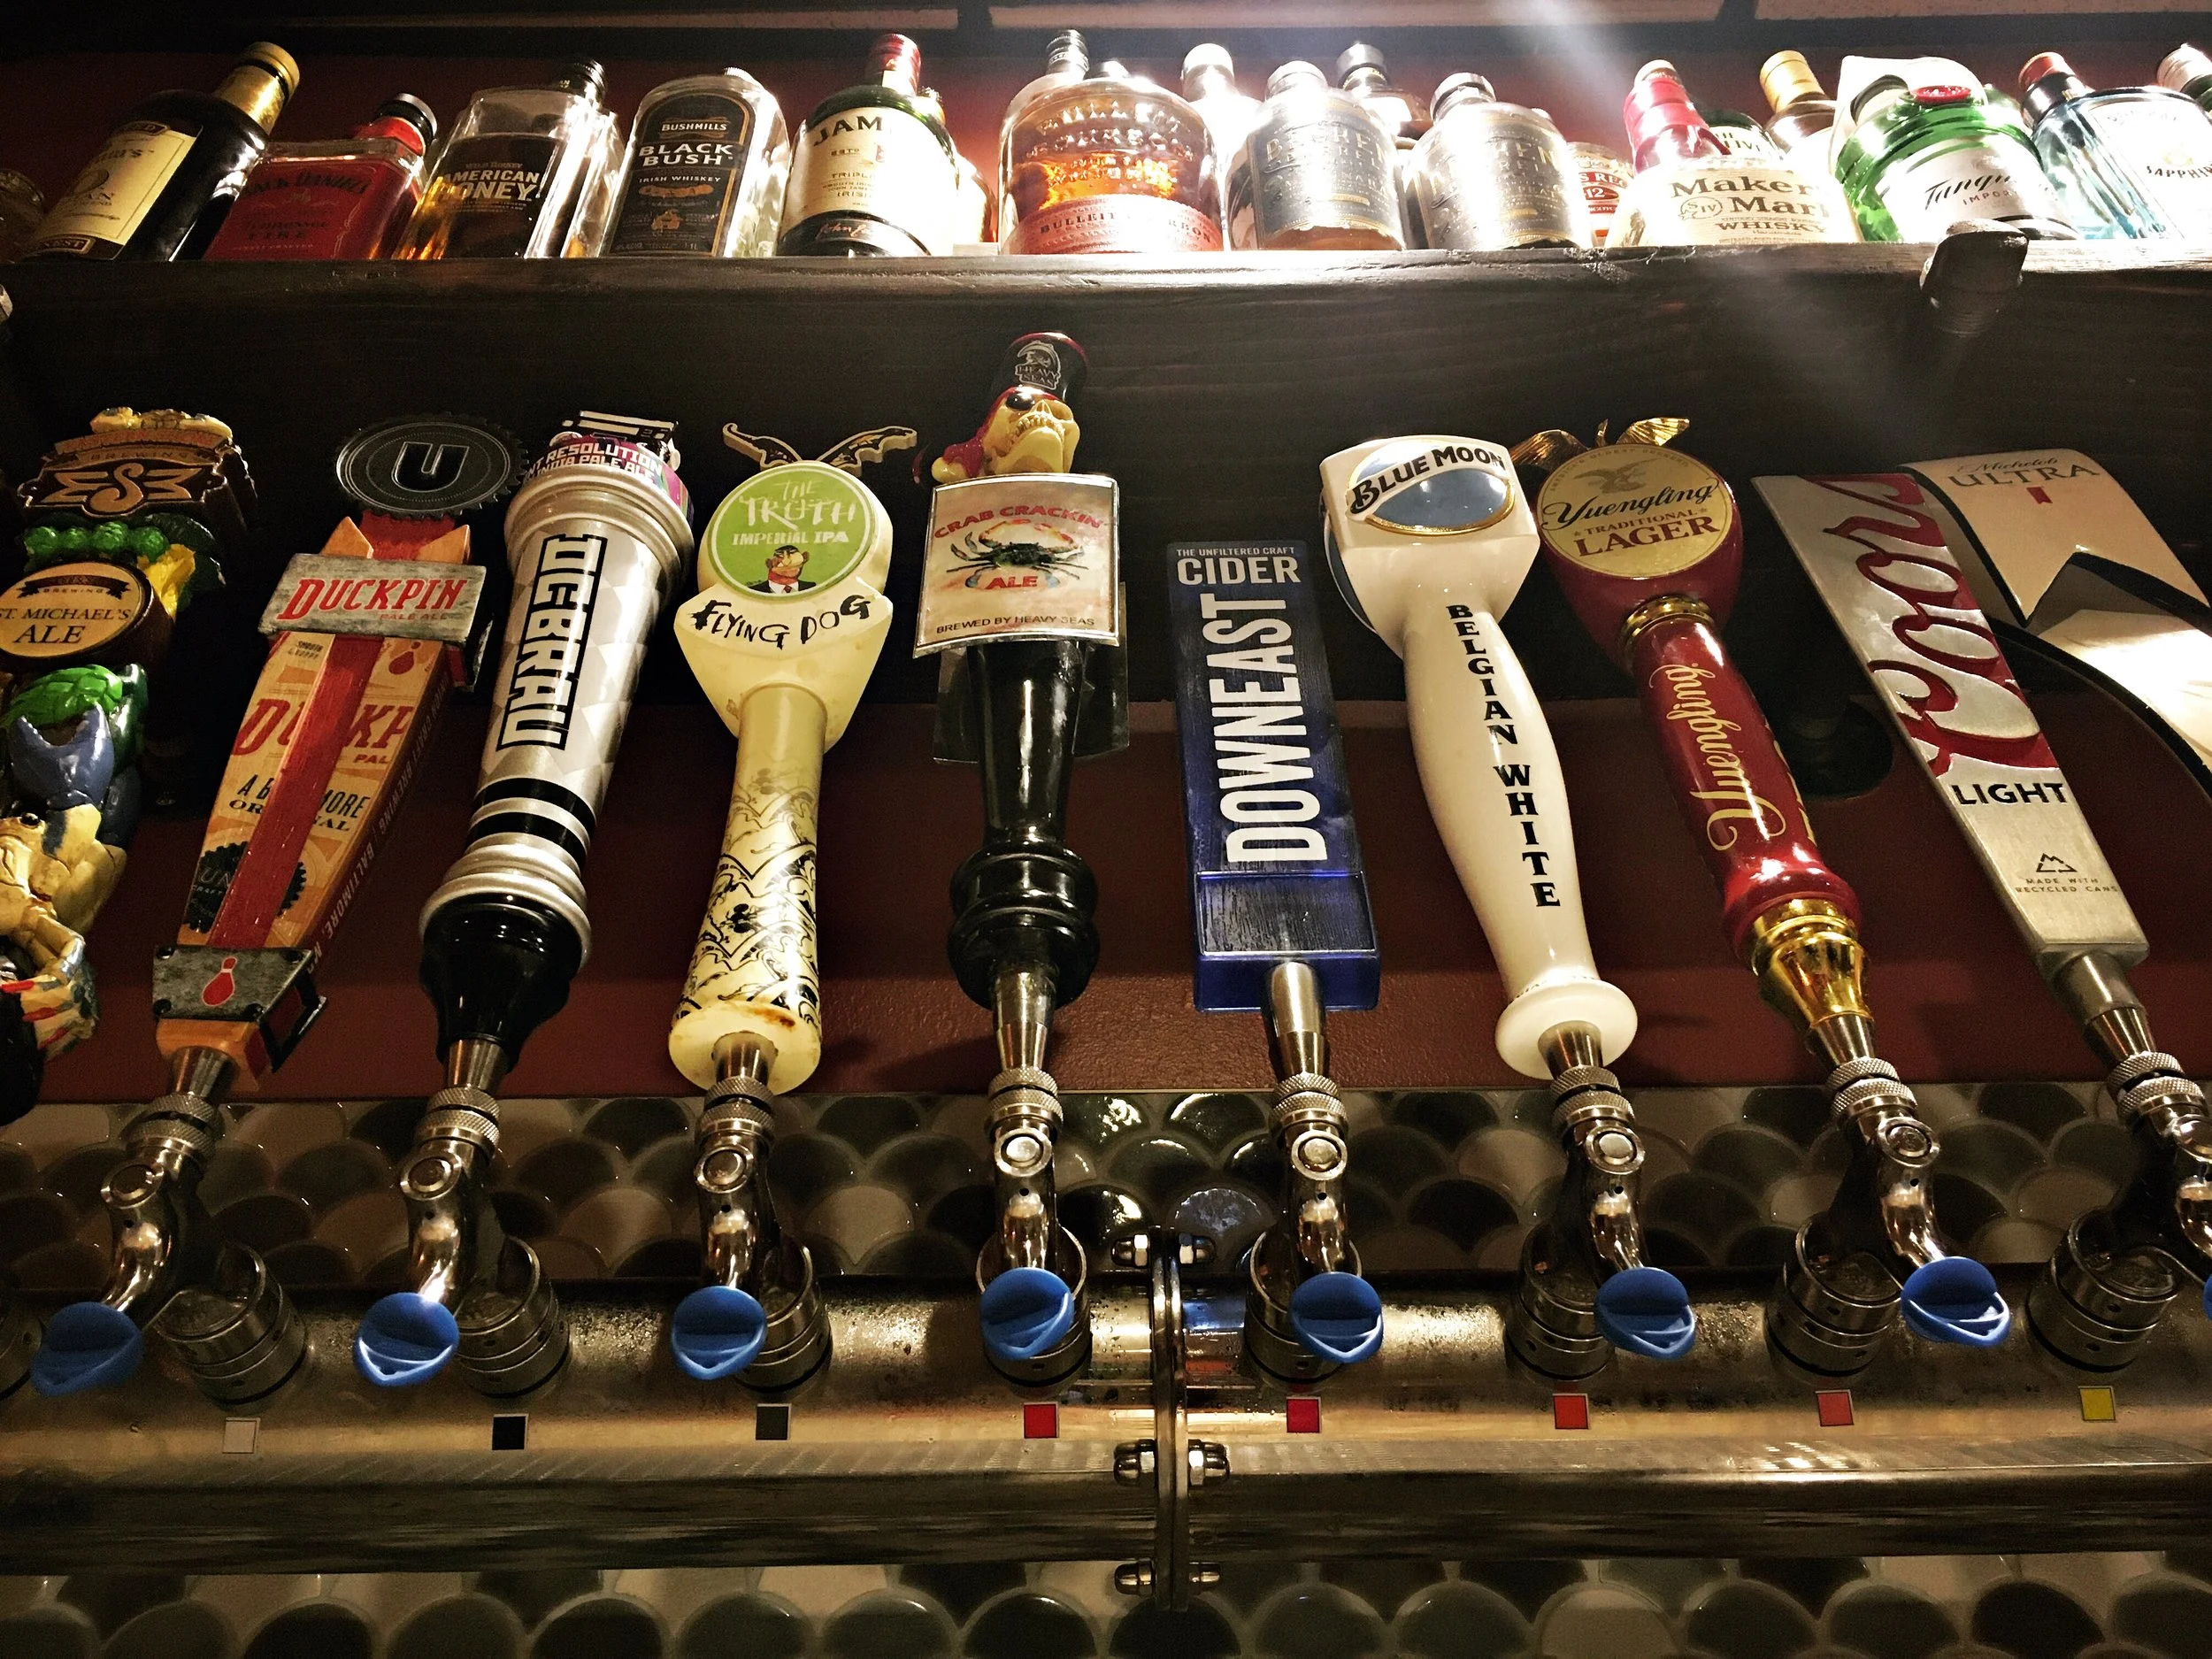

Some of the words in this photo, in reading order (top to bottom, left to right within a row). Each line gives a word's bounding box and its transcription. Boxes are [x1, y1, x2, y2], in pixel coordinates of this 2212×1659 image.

[662, 123, 728, 132] BUSHMILLS
[639, 143, 734, 157] BLACK
[642, 154, 723, 166] BUSH
[442, 169, 541, 184] AMERICAN
[2146, 163, 2212, 179] SAPPHIR
[449, 181, 538, 202] ONEY
[391, 441, 470, 493] U
[545, 442, 664, 477] RESOLUTION
[579, 454, 623, 470] PALE
[1349, 457, 1431, 515] BLUE
[1432, 445, 1507, 472] MOON
[1947, 463, 2101, 488] ULTRA
[774, 480, 822, 501] THE
[739, 495, 856, 531] TRUTH
[1541, 477, 1720, 531] Yuengling
[933, 509, 995, 540] CRAB
[1584, 509, 1699, 536] TRADITIONAL
[731, 531, 809, 546] IMPERIAL
[814, 531, 849, 545] IPA
[1573, 515, 1721, 557] LAGER
[1176, 548, 1196, 557] THE
[1198, 547, 1261, 557] UNFILTERED
[1263, 546, 1295, 555] CRAFT
[984, 574, 1039, 590] ALE
[1176, 555, 1302, 586] CIDER
[275, 578, 468, 622] DUCKPIN
[20, 607, 132, 621] MICHAEL'S
[691, 599, 791, 650] FLYING
[799, 594, 872, 645] DOG
[936, 617, 991, 634] BREWED
[994, 616, 1010, 626] BY
[1014, 615, 1057, 625] HEAVY
[1061, 617, 1095, 627] SEAS
[14, 625, 86, 644] ALE
[1445, 603, 1518, 746] BELGIAN
[1199, 592, 1329, 864] DOWNEAST
[1648, 661, 1787, 851] Yuengling
[1950, 782, 2069, 805] LIGHT
[1493, 764, 1562, 908] WHITE
[2025, 877, 2060, 886] MADE
